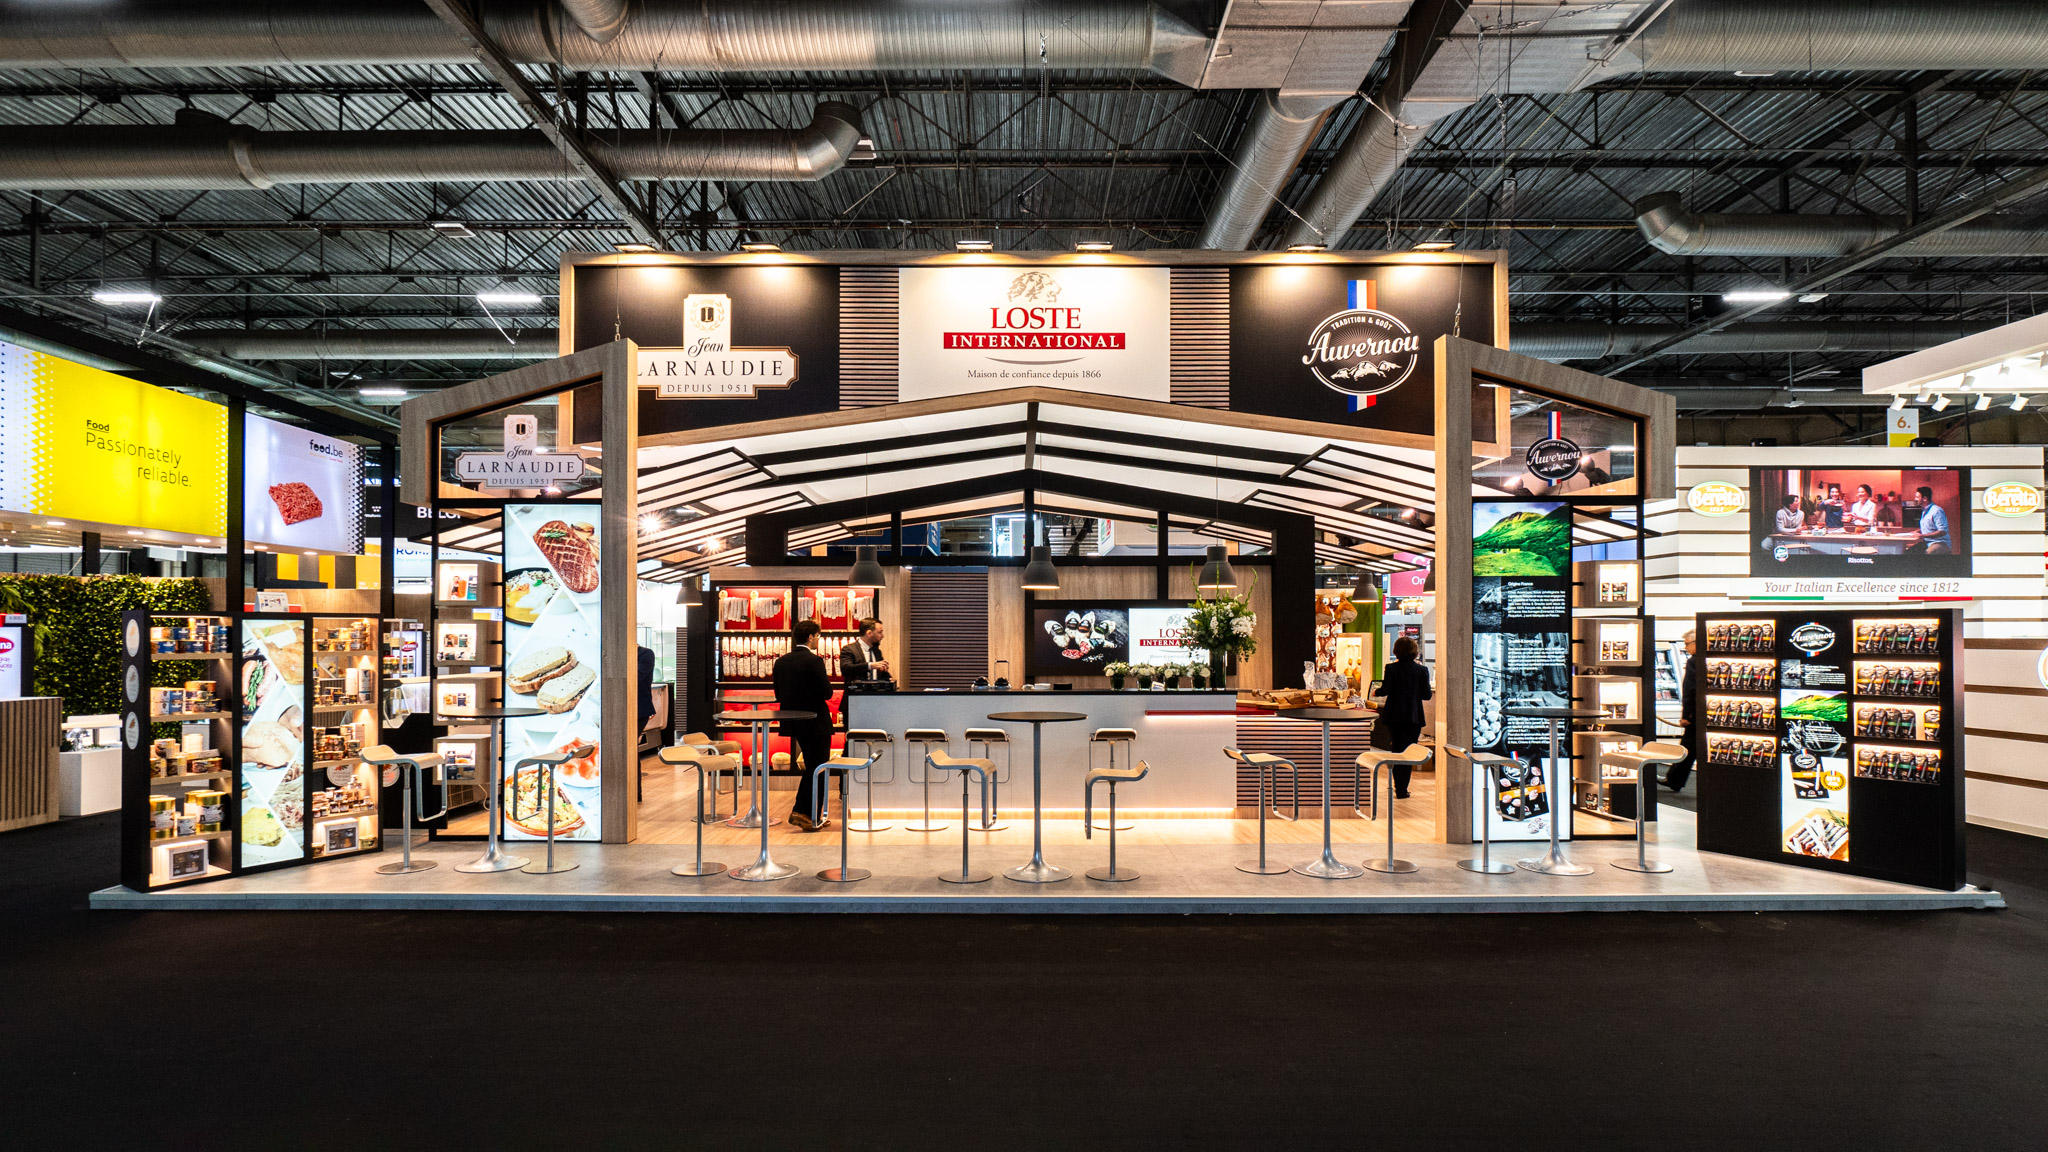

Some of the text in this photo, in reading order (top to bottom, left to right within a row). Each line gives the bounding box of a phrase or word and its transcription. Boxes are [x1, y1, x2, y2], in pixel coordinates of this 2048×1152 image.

[990, 307, 1082, 329] LOSTE
[1331, 316, 1366, 330] TRADITION
[688, 337, 724, 358] Jean
[951, 335, 1120, 348] INTERNATIONAL
[1302, 331, 1420, 365] Auvernou
[967, 369, 1102, 381] Maison de confiance depuis 1866
[667, 384, 748, 393] DEPUIS 1951
[86, 419, 110, 432] Food
[86, 431, 181, 469] Passionately
[309, 439, 343, 458] food.be
[507, 445, 533, 460] Jean
[1526, 449, 1581, 466] Auvernou
[467, 461, 575, 473] LARNAUDIE
[137, 466, 191, 487] reliable.
[1765, 582, 1960, 593] Your Italian Excellence since 1812
